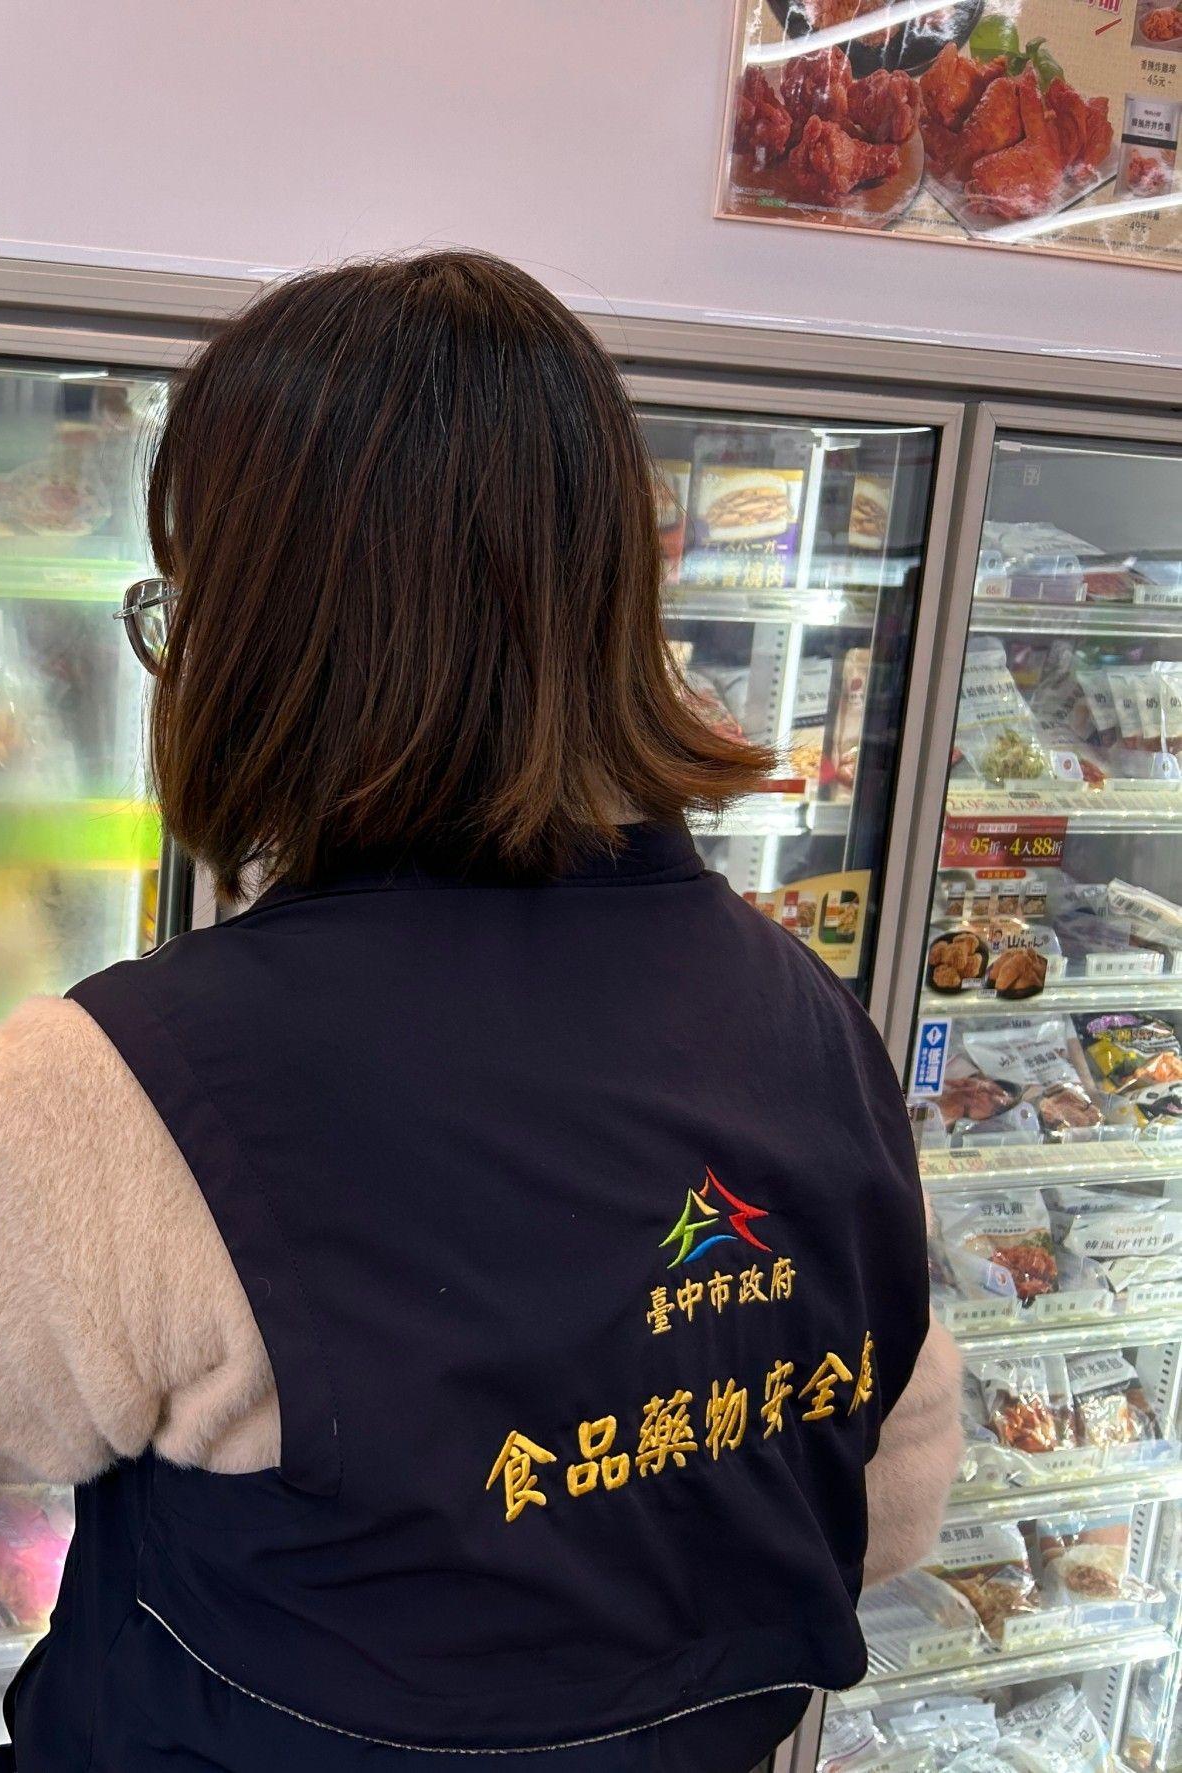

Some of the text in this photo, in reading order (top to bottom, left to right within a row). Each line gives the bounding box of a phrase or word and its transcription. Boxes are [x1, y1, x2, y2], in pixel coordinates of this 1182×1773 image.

[647, 1256, 796, 1335] 臺中市政府
